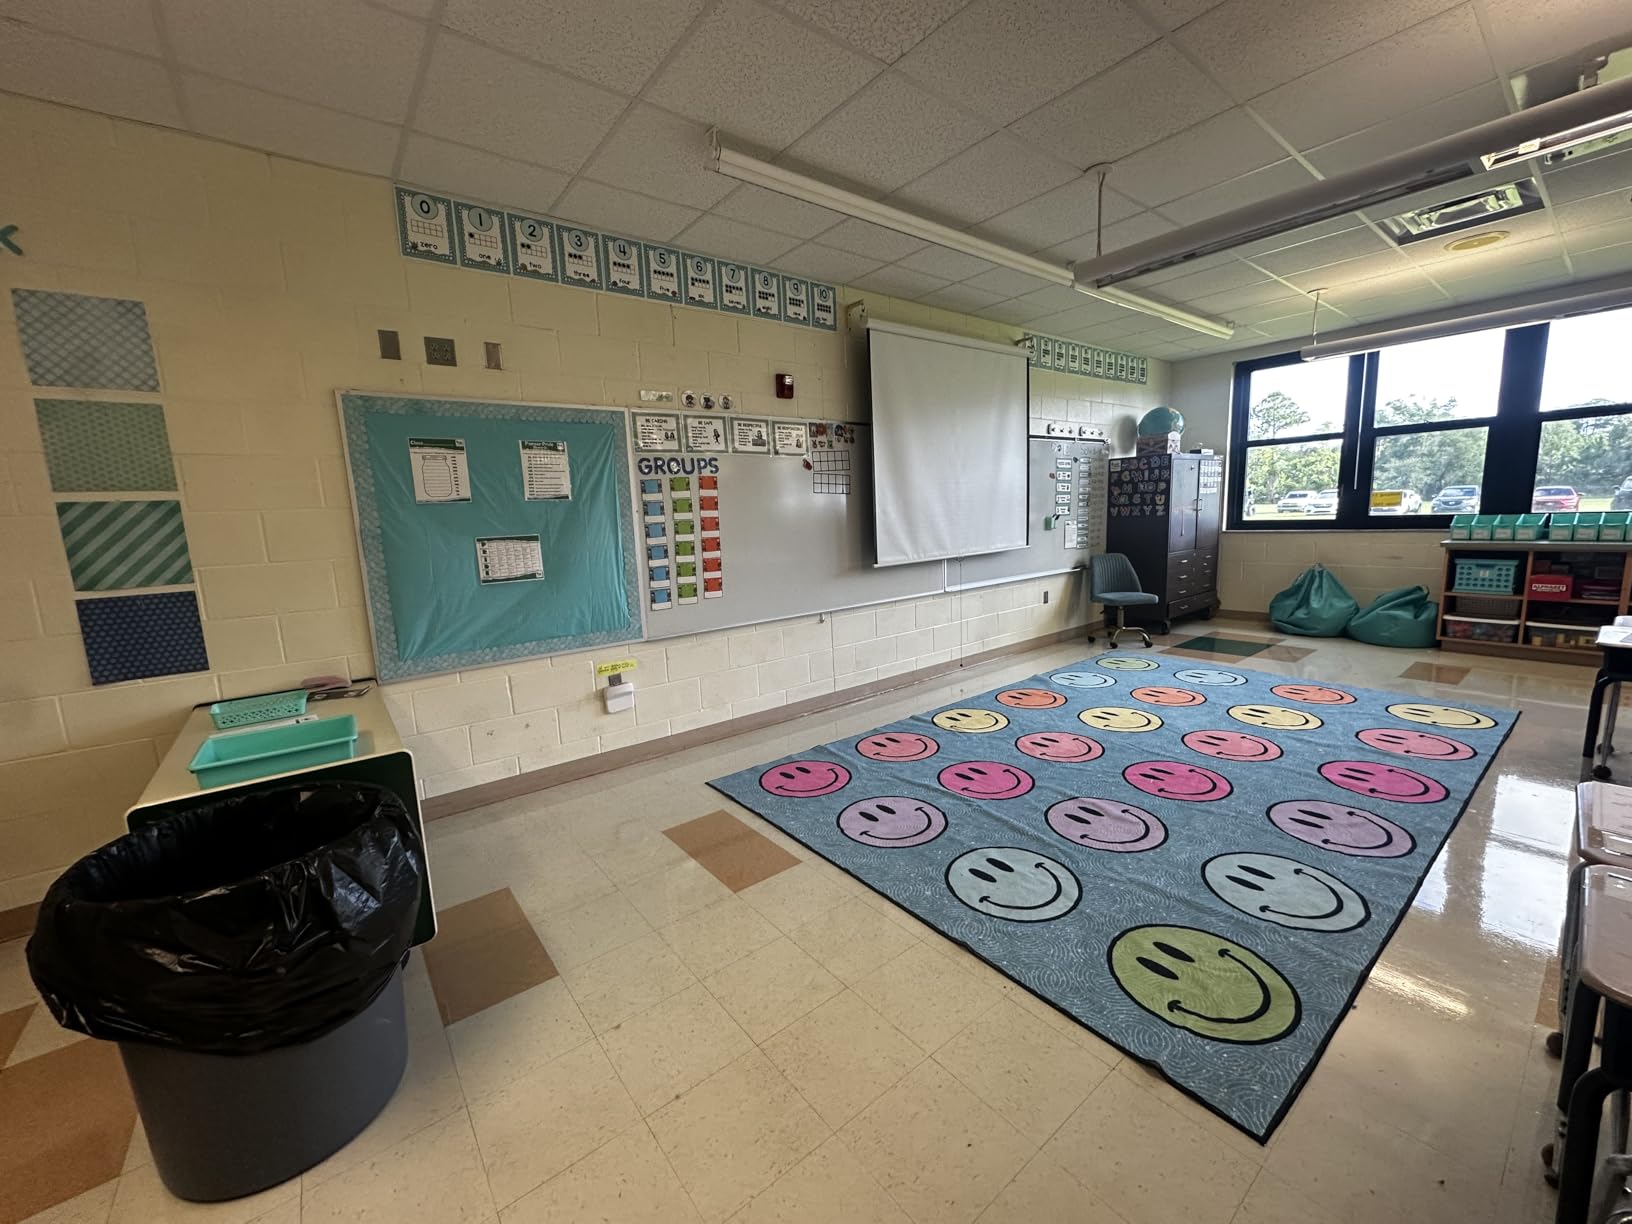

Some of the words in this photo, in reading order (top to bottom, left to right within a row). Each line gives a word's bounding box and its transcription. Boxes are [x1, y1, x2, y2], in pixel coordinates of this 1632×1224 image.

[419, 199, 431, 214] 0
[477, 213, 483, 227] 1
[527, 224, 537, 238] 2
[420, 241, 438, 250] zero
[574, 234, 583, 247] 3
[618, 244, 627, 257] 4
[478, 253, 492, 261] one
[658, 252, 666, 264] 5
[528, 262, 542, 270] two
[695, 261, 703, 272] 6
[573, 270, 590, 278] three
[730, 268, 736, 279] 7
[619, 278, 631, 286] four
[763, 275, 769, 286] 8
[793, 283, 799, 293] 9
[819, 288, 827, 299] 10
[637, 457, 720, 475] GROUPS
